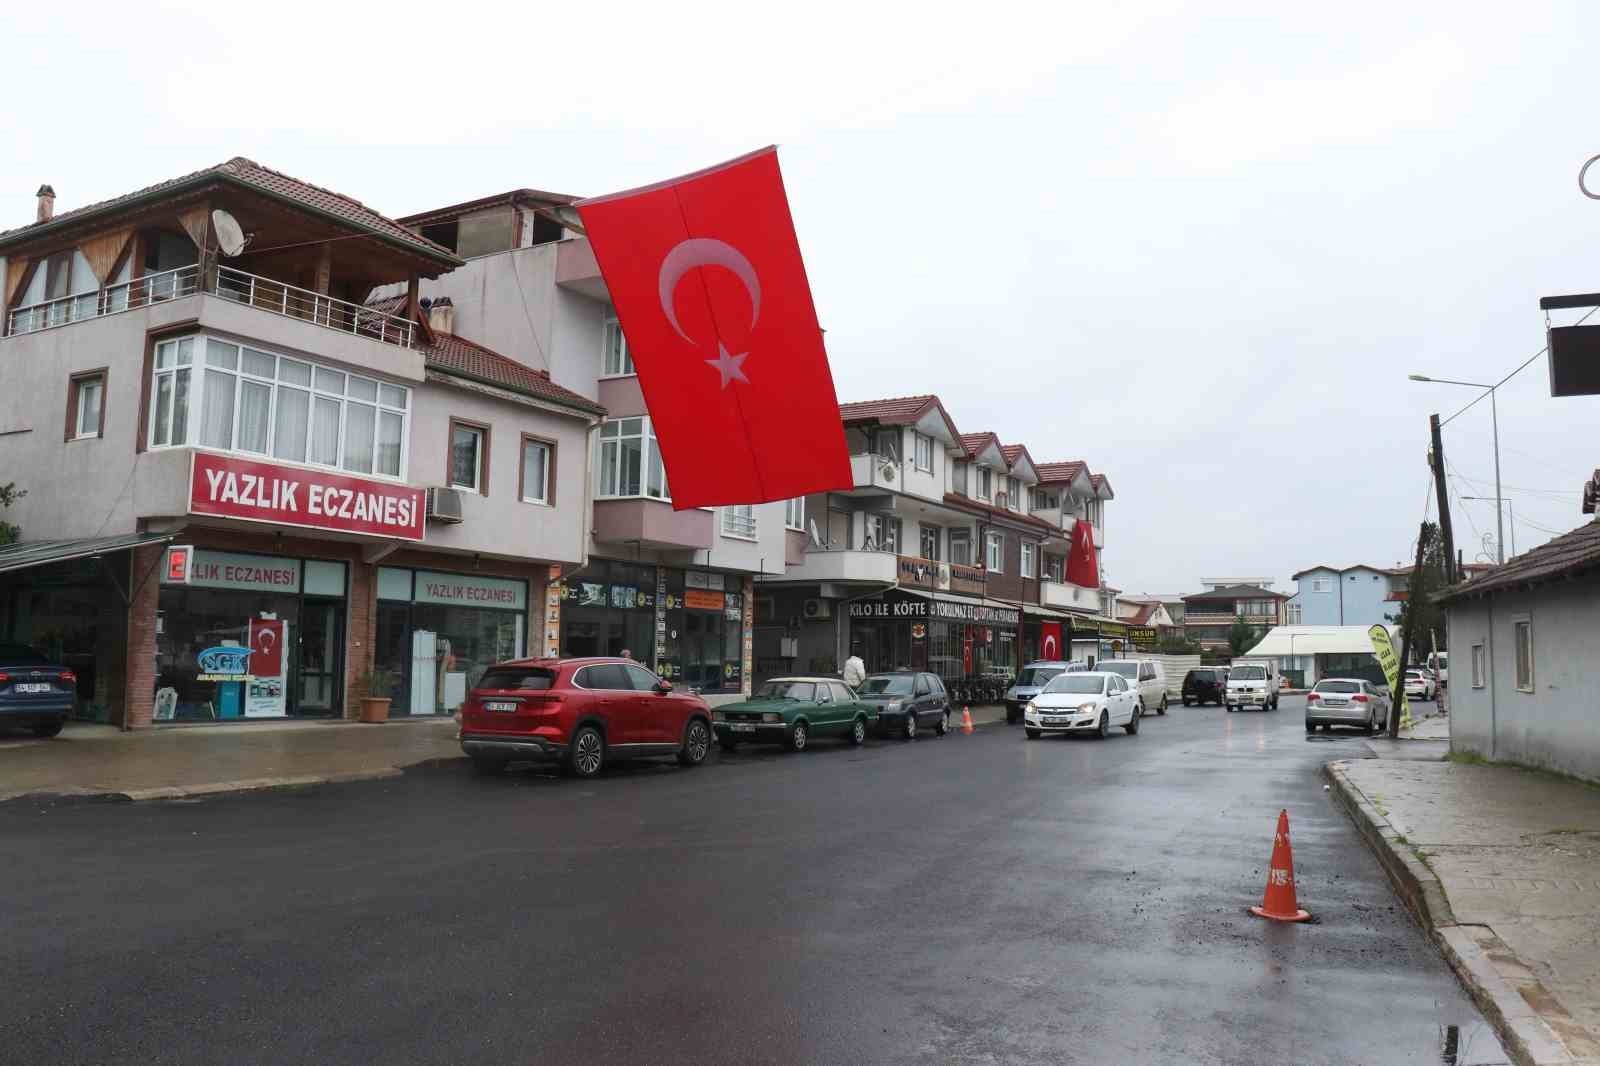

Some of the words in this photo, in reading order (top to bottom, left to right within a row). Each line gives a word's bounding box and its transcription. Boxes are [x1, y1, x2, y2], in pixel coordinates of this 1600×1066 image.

[204, 468, 300, 512] YAZLIK
[308, 484, 418, 528] ECZANESİ
[171, 552, 186, 578] E
[224, 565, 295, 586] ECZANESİ
[426, 583, 464, 600] YAZLIK
[466, 587, 516, 605] ECZANESİ
[894, 601, 926, 616] KÖFTE
[936, 602, 967, 618] YORULMAZ
[203, 654, 246, 674] SGK
